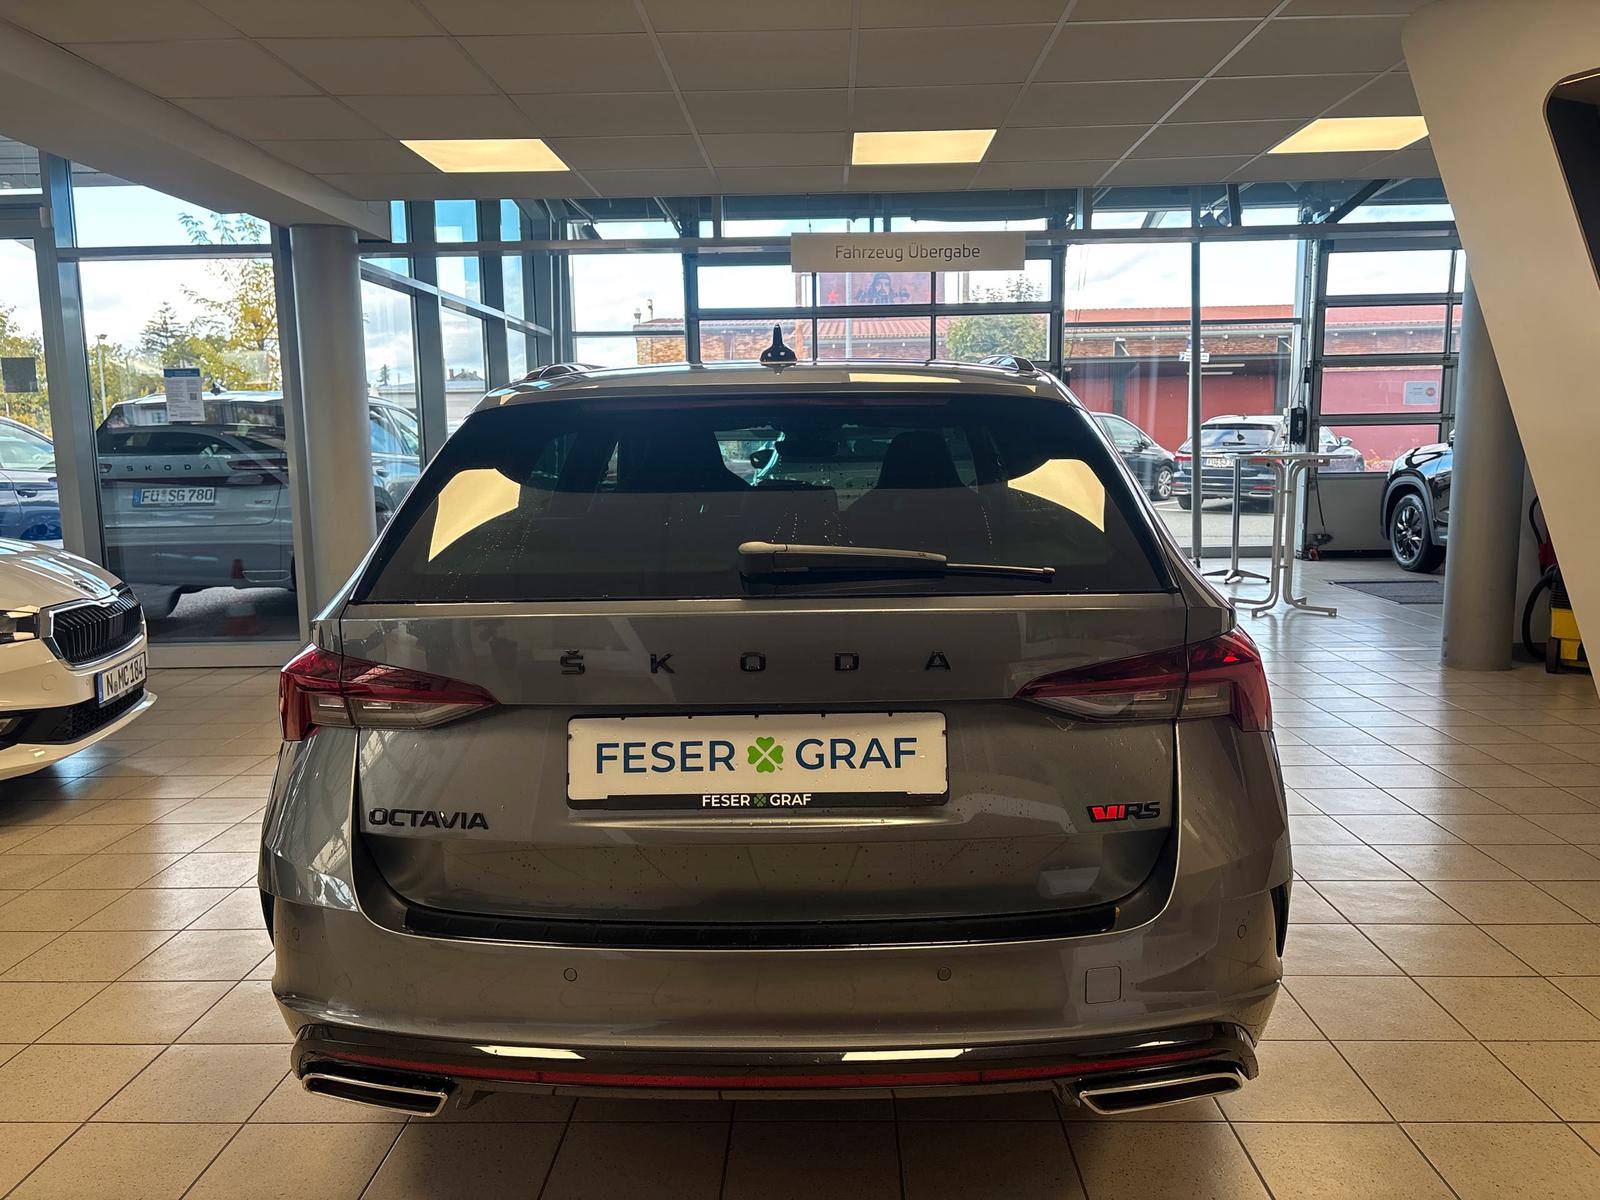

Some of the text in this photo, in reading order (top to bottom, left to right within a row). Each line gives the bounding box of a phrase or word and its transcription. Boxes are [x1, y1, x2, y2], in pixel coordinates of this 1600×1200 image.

[835, 241, 981, 262] Fahrzeug Übergabe
[141, 488, 214, 503] FÜ SG 780
[559, 648, 952, 676] ŠKODA
[106, 672, 114, 697] N
[118, 664, 130, 690] MC
[595, 736, 918, 775] FESER GRAF
[702, 793, 812, 807] FESER GRAF
[368, 807, 490, 830] OCTAVIA
